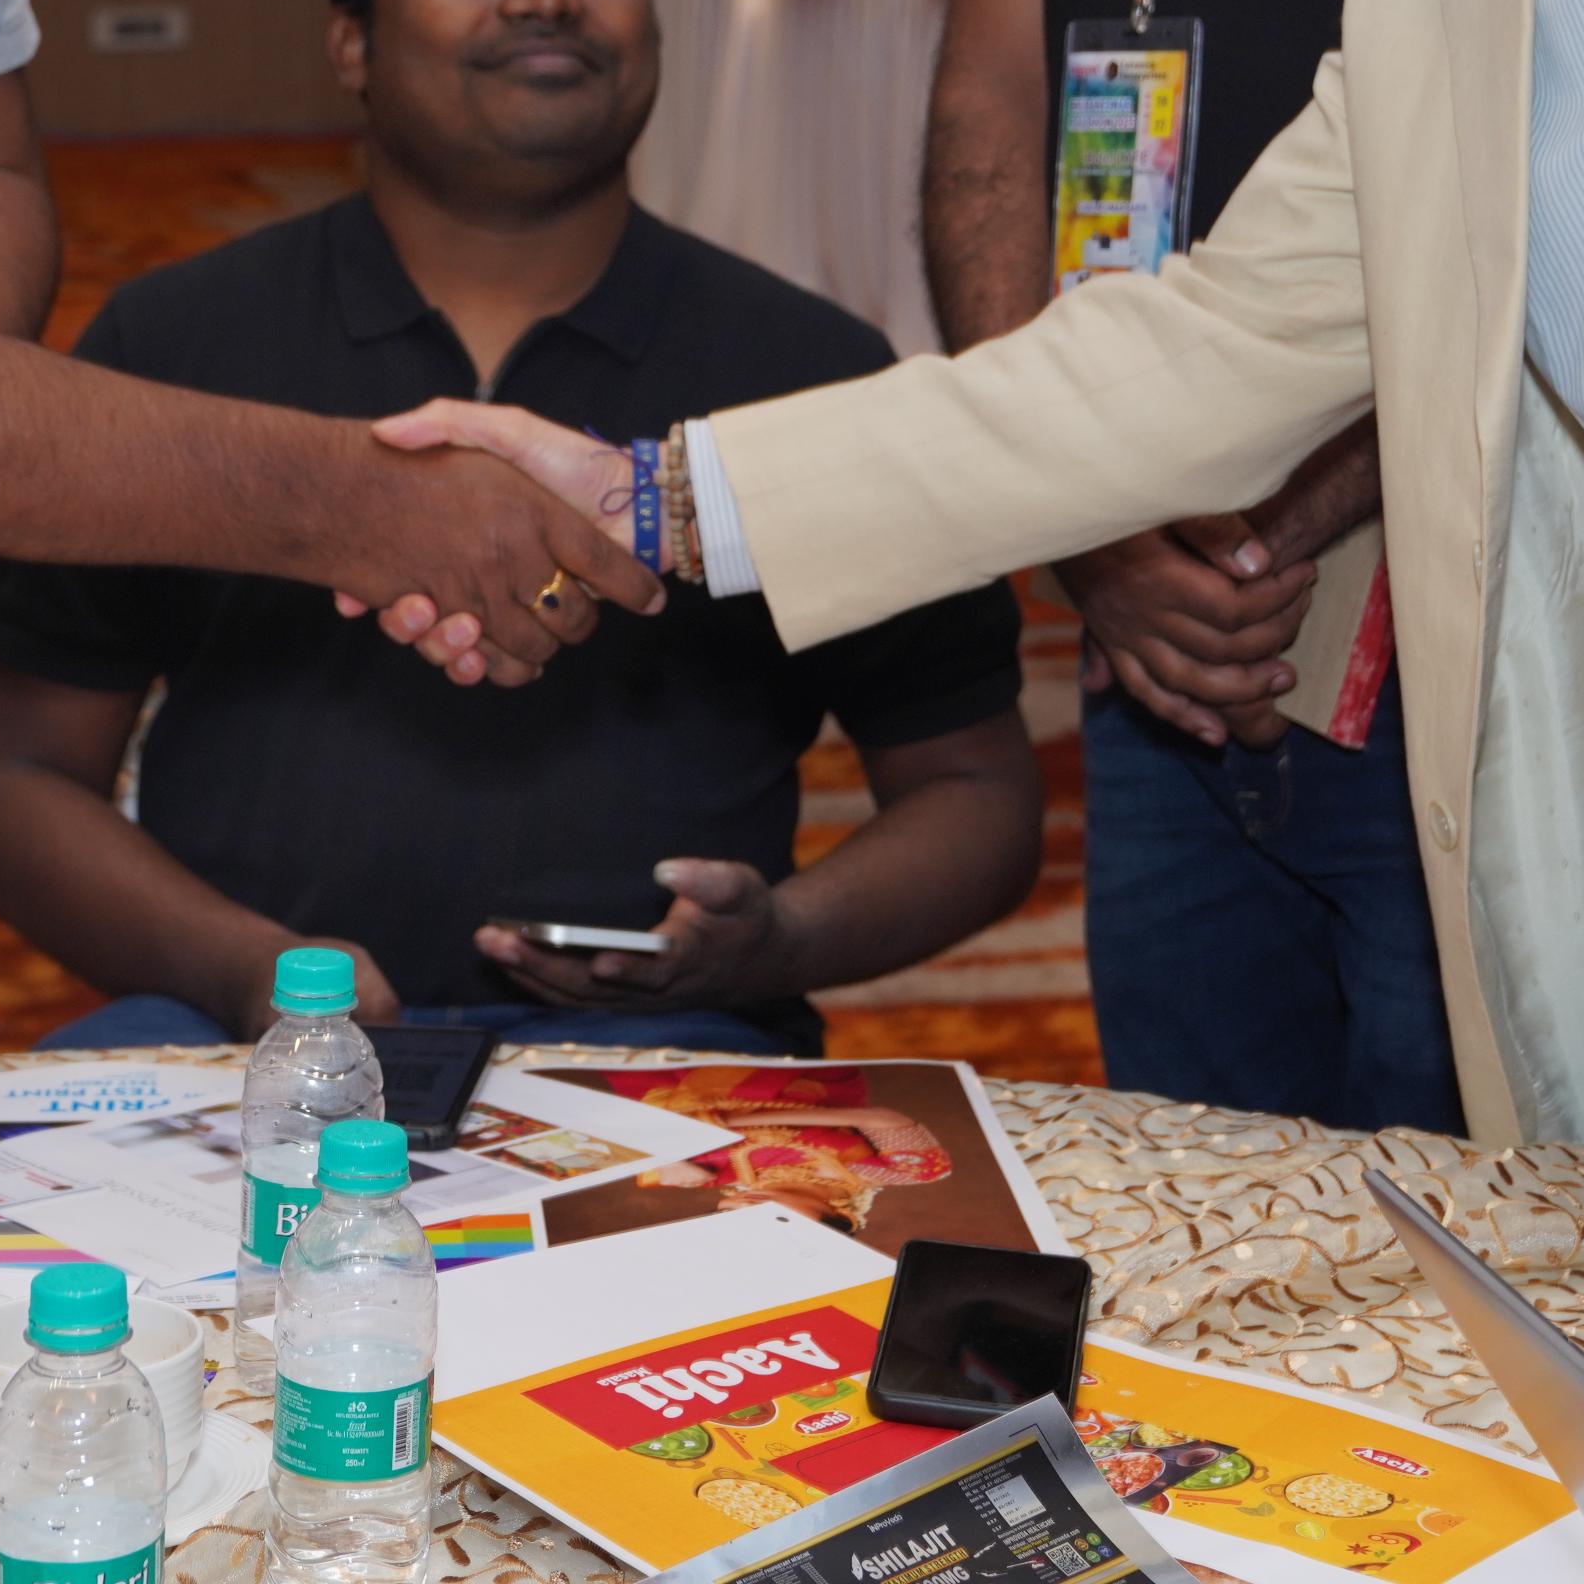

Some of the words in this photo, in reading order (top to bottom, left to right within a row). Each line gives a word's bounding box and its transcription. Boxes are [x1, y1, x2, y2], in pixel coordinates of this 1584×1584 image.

[596, 1365, 653, 1388] Masala
[615, 1331, 841, 1420] Aachi
[797, 1409, 851, 1434] Aachi
[1352, 1448, 1428, 1476] Aachi
[861, 1524, 957, 1581] SHILAJIT
[925, 1549, 968, 1574] STRENGTH
